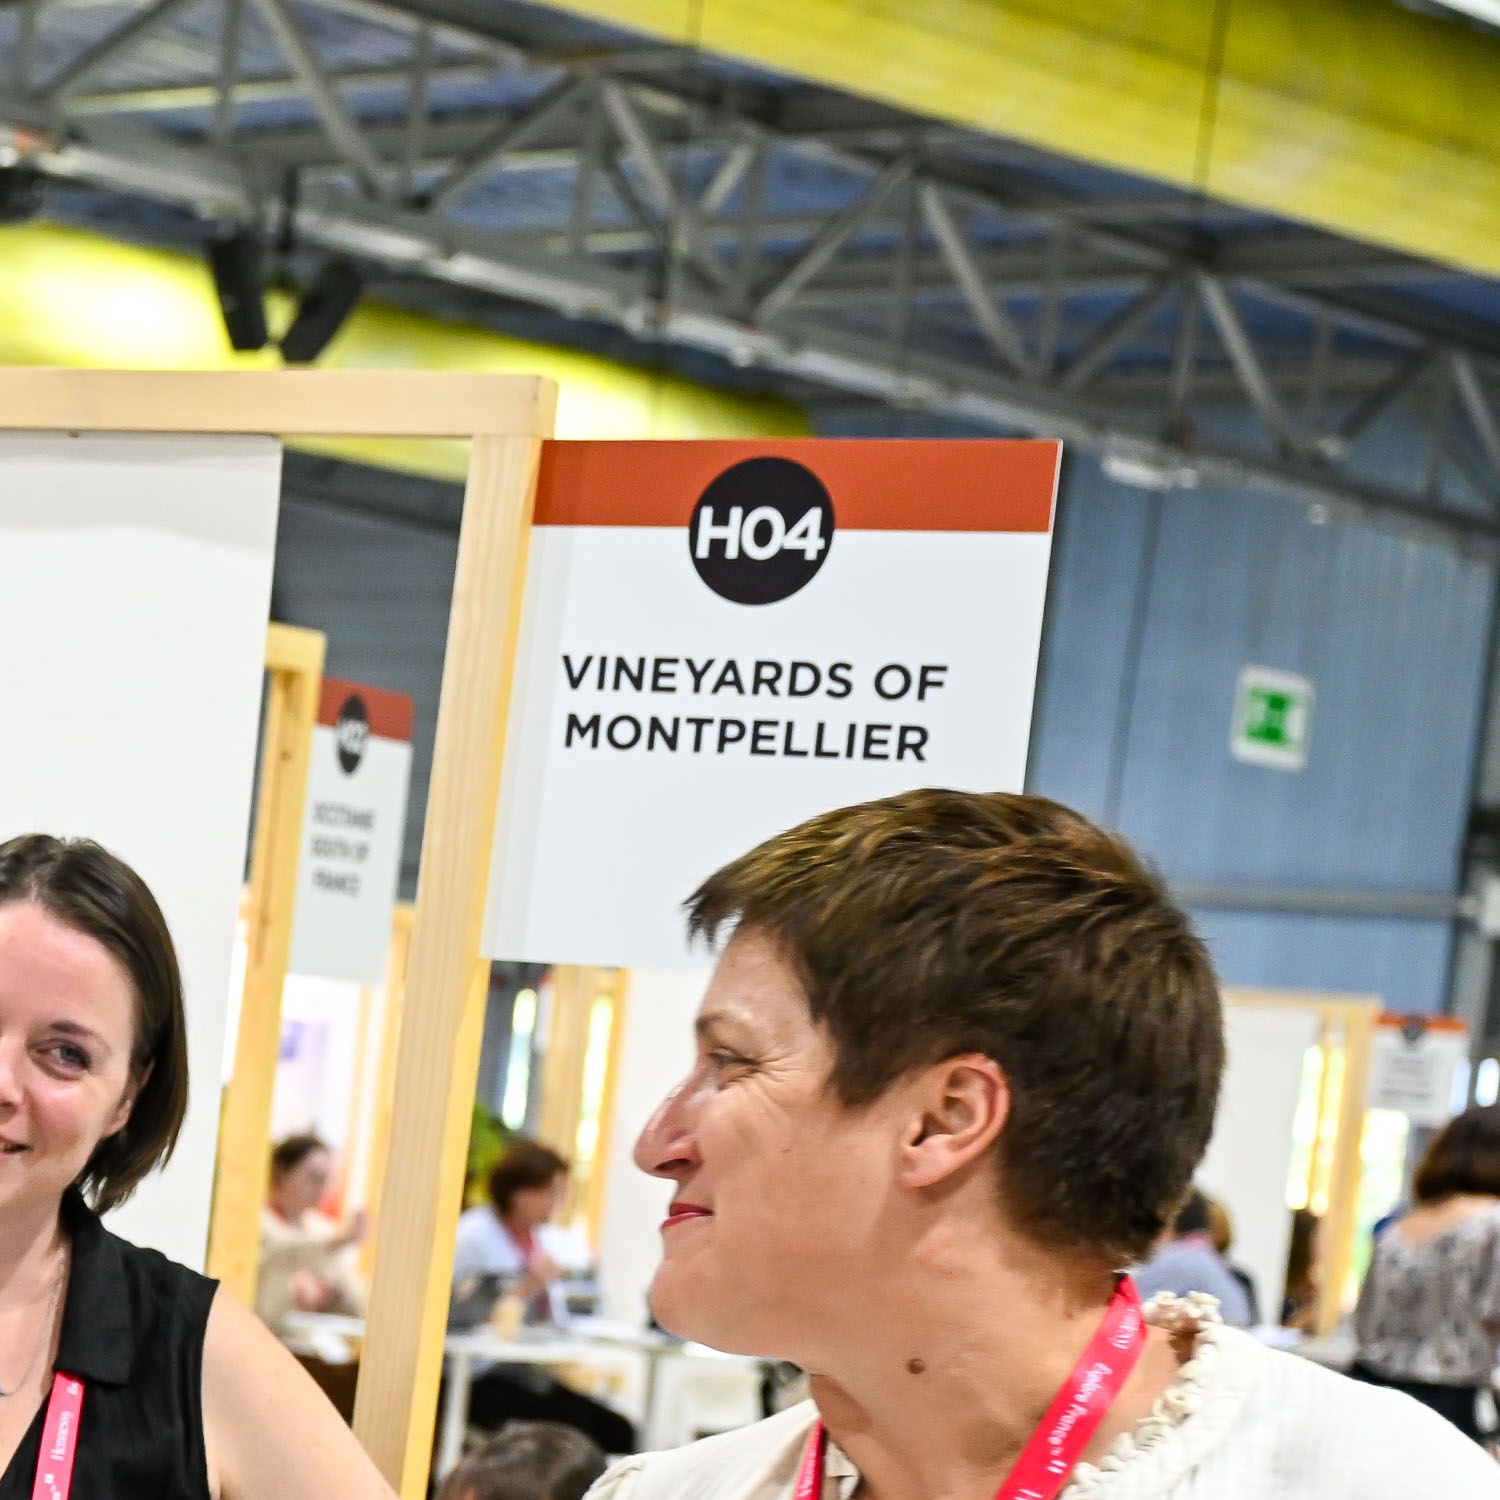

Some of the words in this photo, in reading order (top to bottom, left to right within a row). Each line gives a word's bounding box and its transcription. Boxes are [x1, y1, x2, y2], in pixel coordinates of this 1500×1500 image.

[695, 505, 826, 562] H04
[562, 654, 853, 700] VINEYARDS
[873, 663, 949, 702] OF
[563, 712, 930, 763] MONTPELLIER
